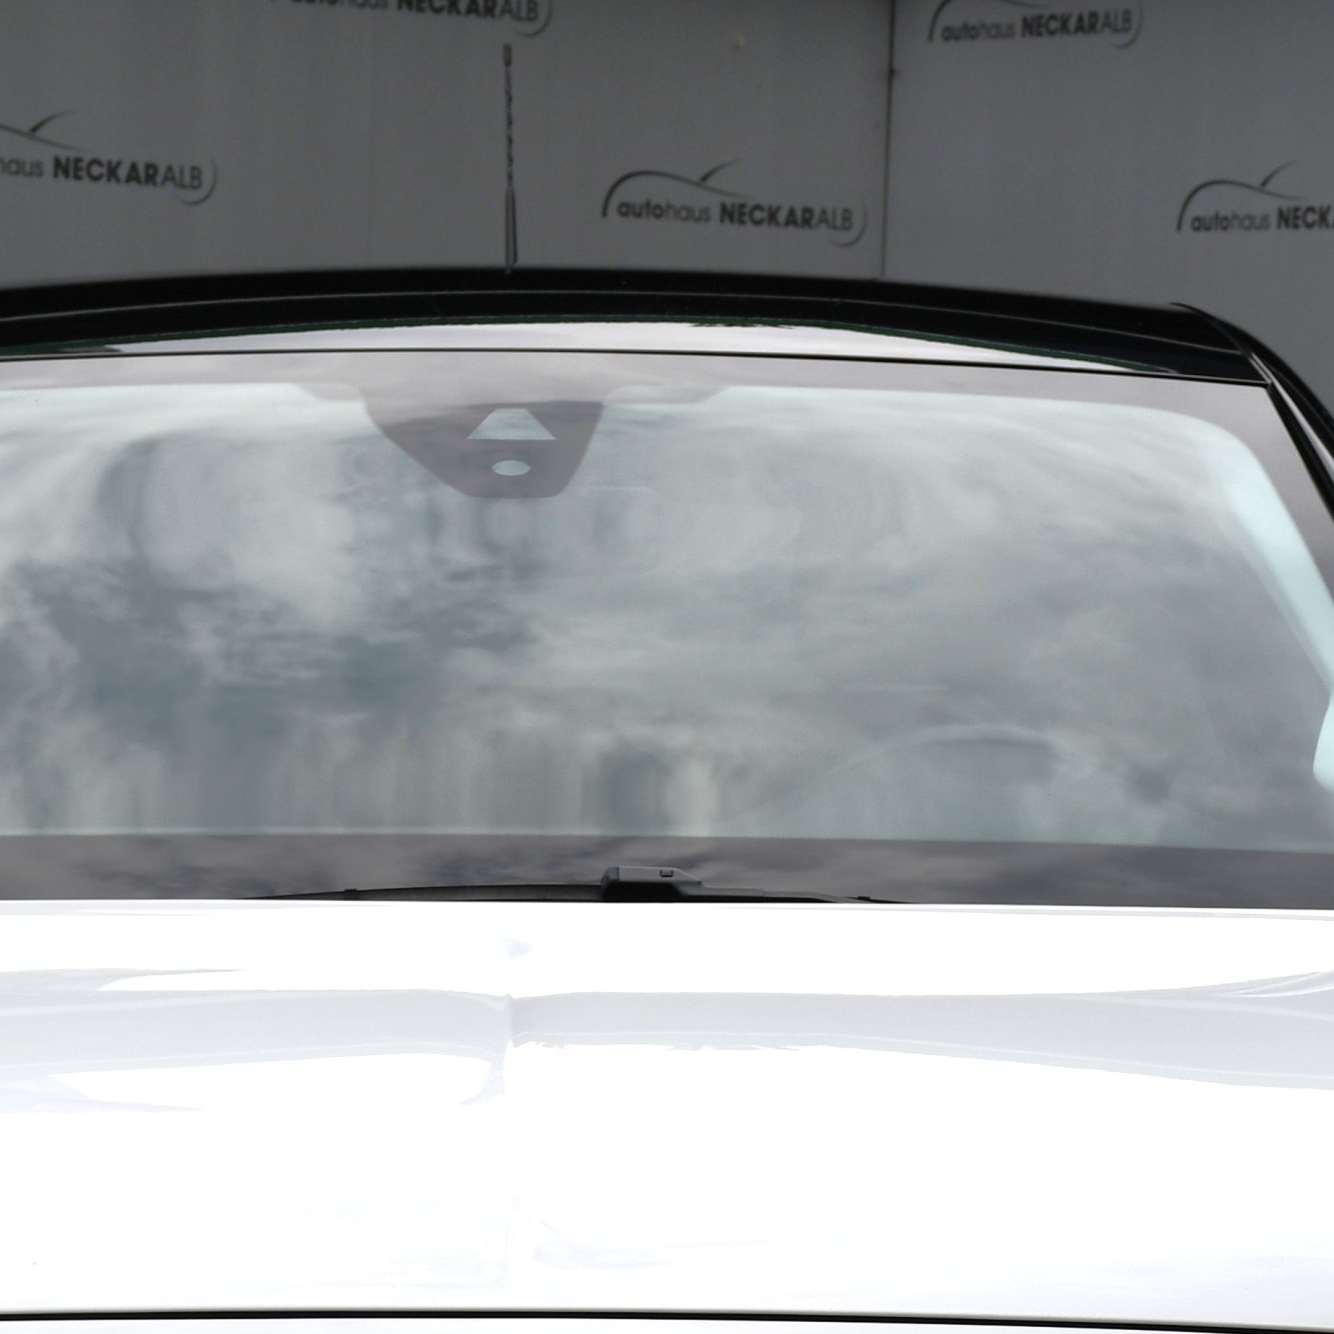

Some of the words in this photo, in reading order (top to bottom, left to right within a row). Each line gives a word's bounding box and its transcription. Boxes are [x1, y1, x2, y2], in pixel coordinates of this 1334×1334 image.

[942, 24, 1015, 41] autohaus
[1021, 15, 1132, 38] NECKARALB
[53, 157, 201, 190] NECKARALB
[618, 199, 710, 223] autohaus
[720, 203, 852, 231] NECKARALB
[1192, 213, 1270, 232] autohaus
